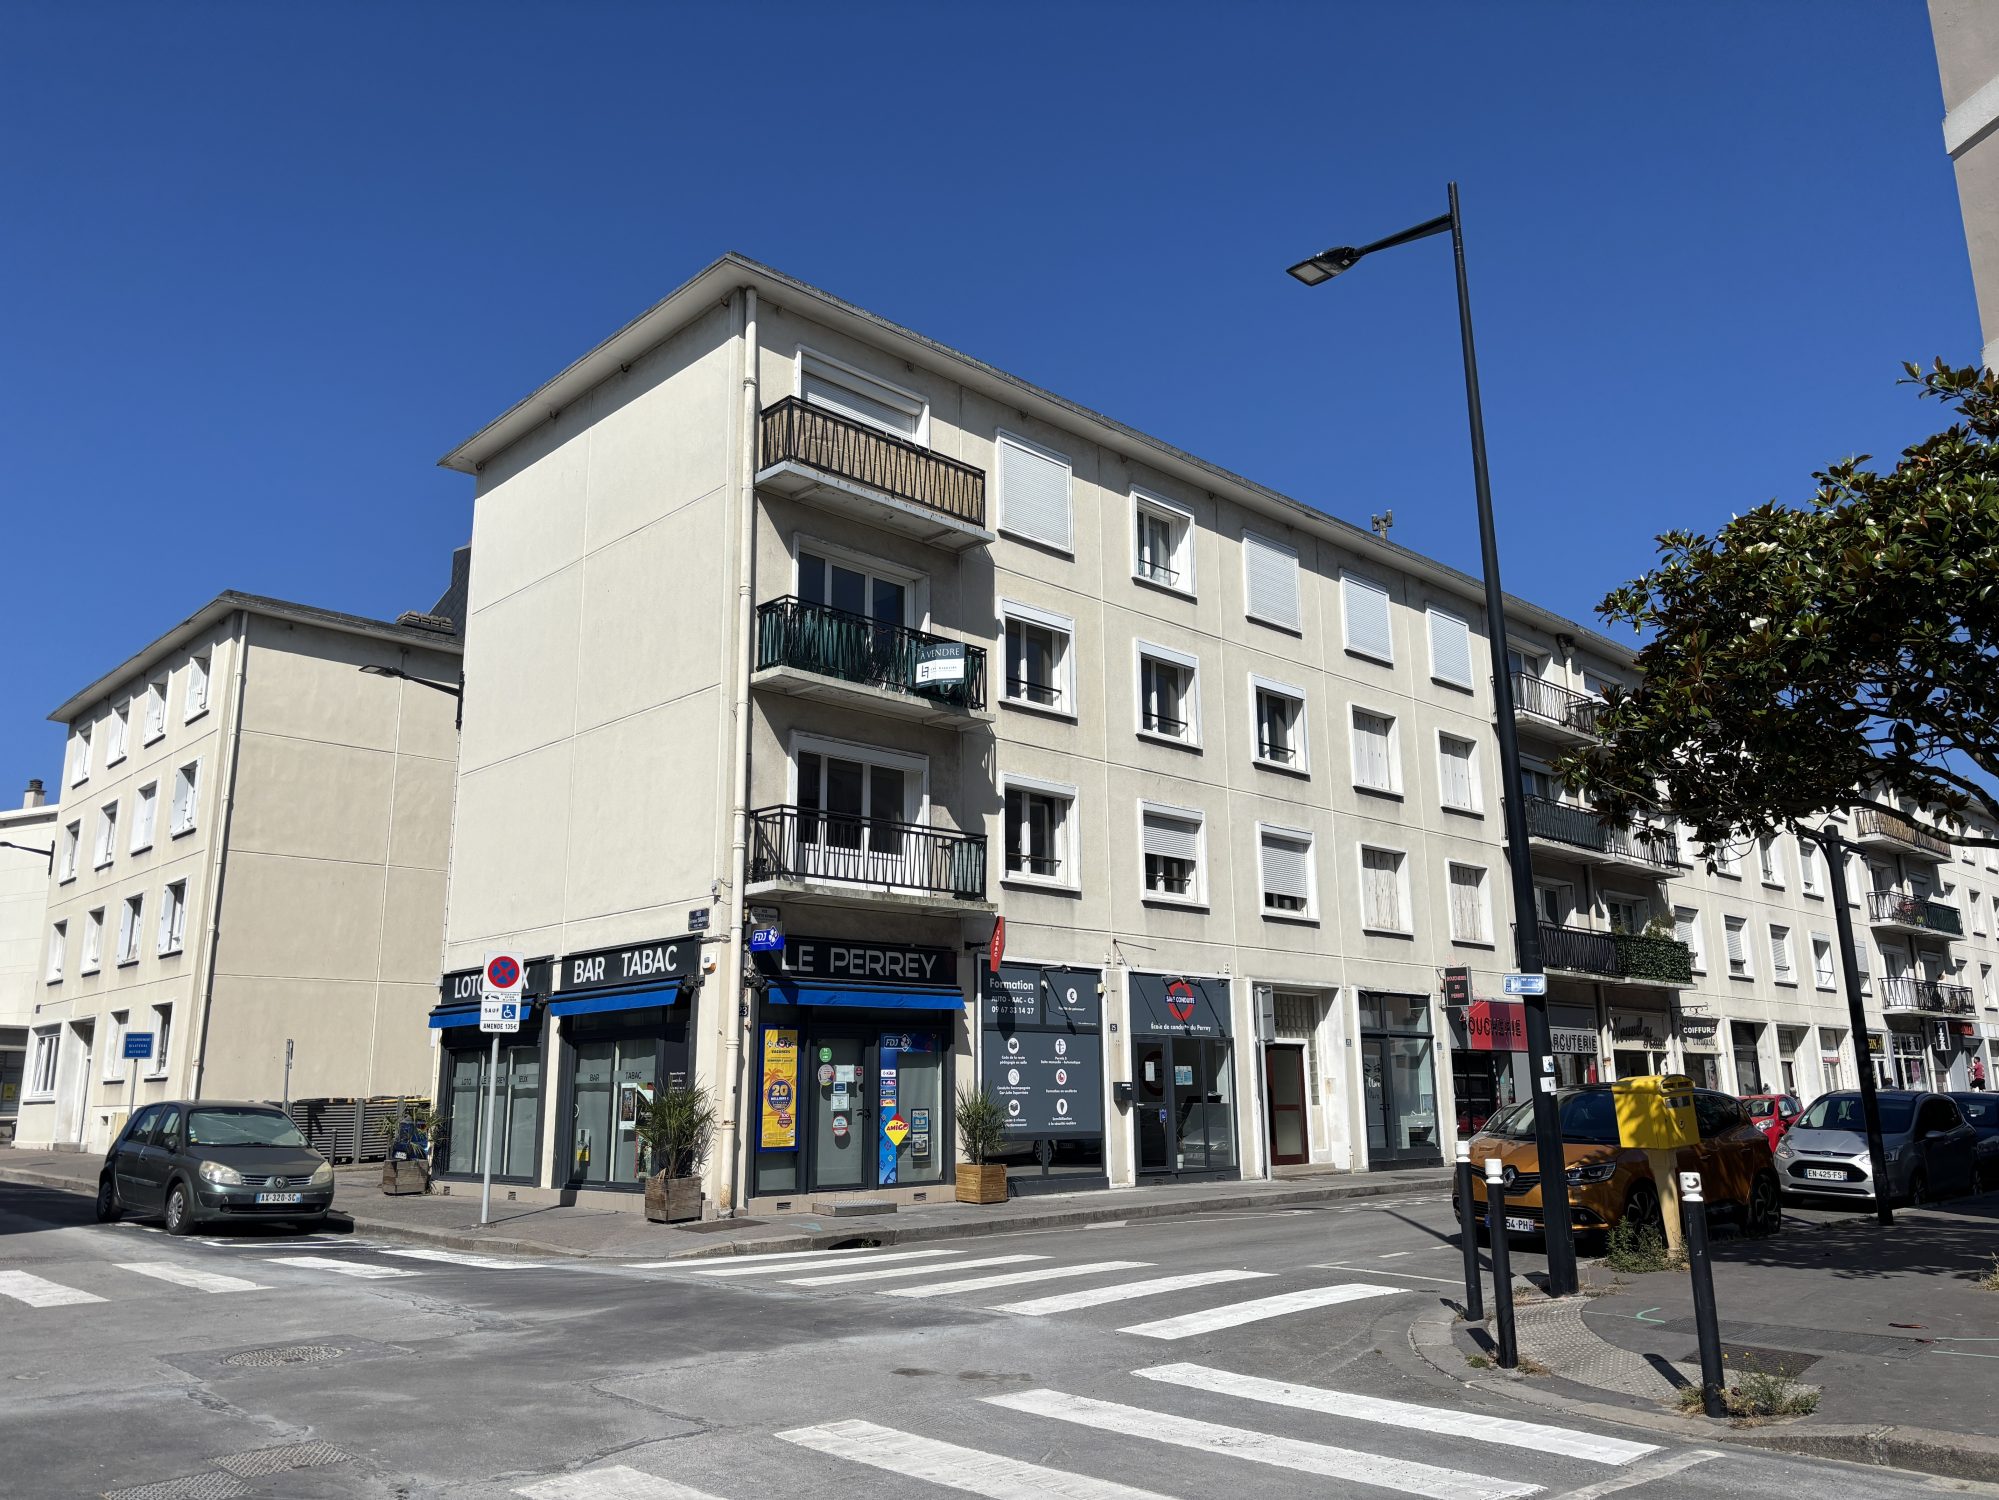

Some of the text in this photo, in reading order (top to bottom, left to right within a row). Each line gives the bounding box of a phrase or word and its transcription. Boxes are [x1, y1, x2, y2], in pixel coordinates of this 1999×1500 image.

[926, 647, 960, 659] VENDRE
[754, 932, 767, 942] FDJ
[573, 945, 678, 984] BAR TABAC
[781, 945, 937, 979] LE PERREY
[989, 978, 1034, 990] Formation
[1012, 996, 1023, 1004] AAC
[991, 1005, 999, 1013] 09
[1018, 1006, 1026, 1014] 14
[1026, 1007, 1034, 1015] 37
[1163, 1022, 1170, 1030] de
[1190, 1023, 1197, 1031] du
[1683, 1026, 1716, 1034] COIFFURE
[885, 1038, 899, 1047] FDJ
[1551, 1033, 1597, 1051] RCUTERIE
[589, 1073, 600, 1082] BAR
[625, 1071, 642, 1080] TABAC
[772, 1084, 788, 1096] 20
[1808, 1169, 1842, 1179] EN-425-FS
